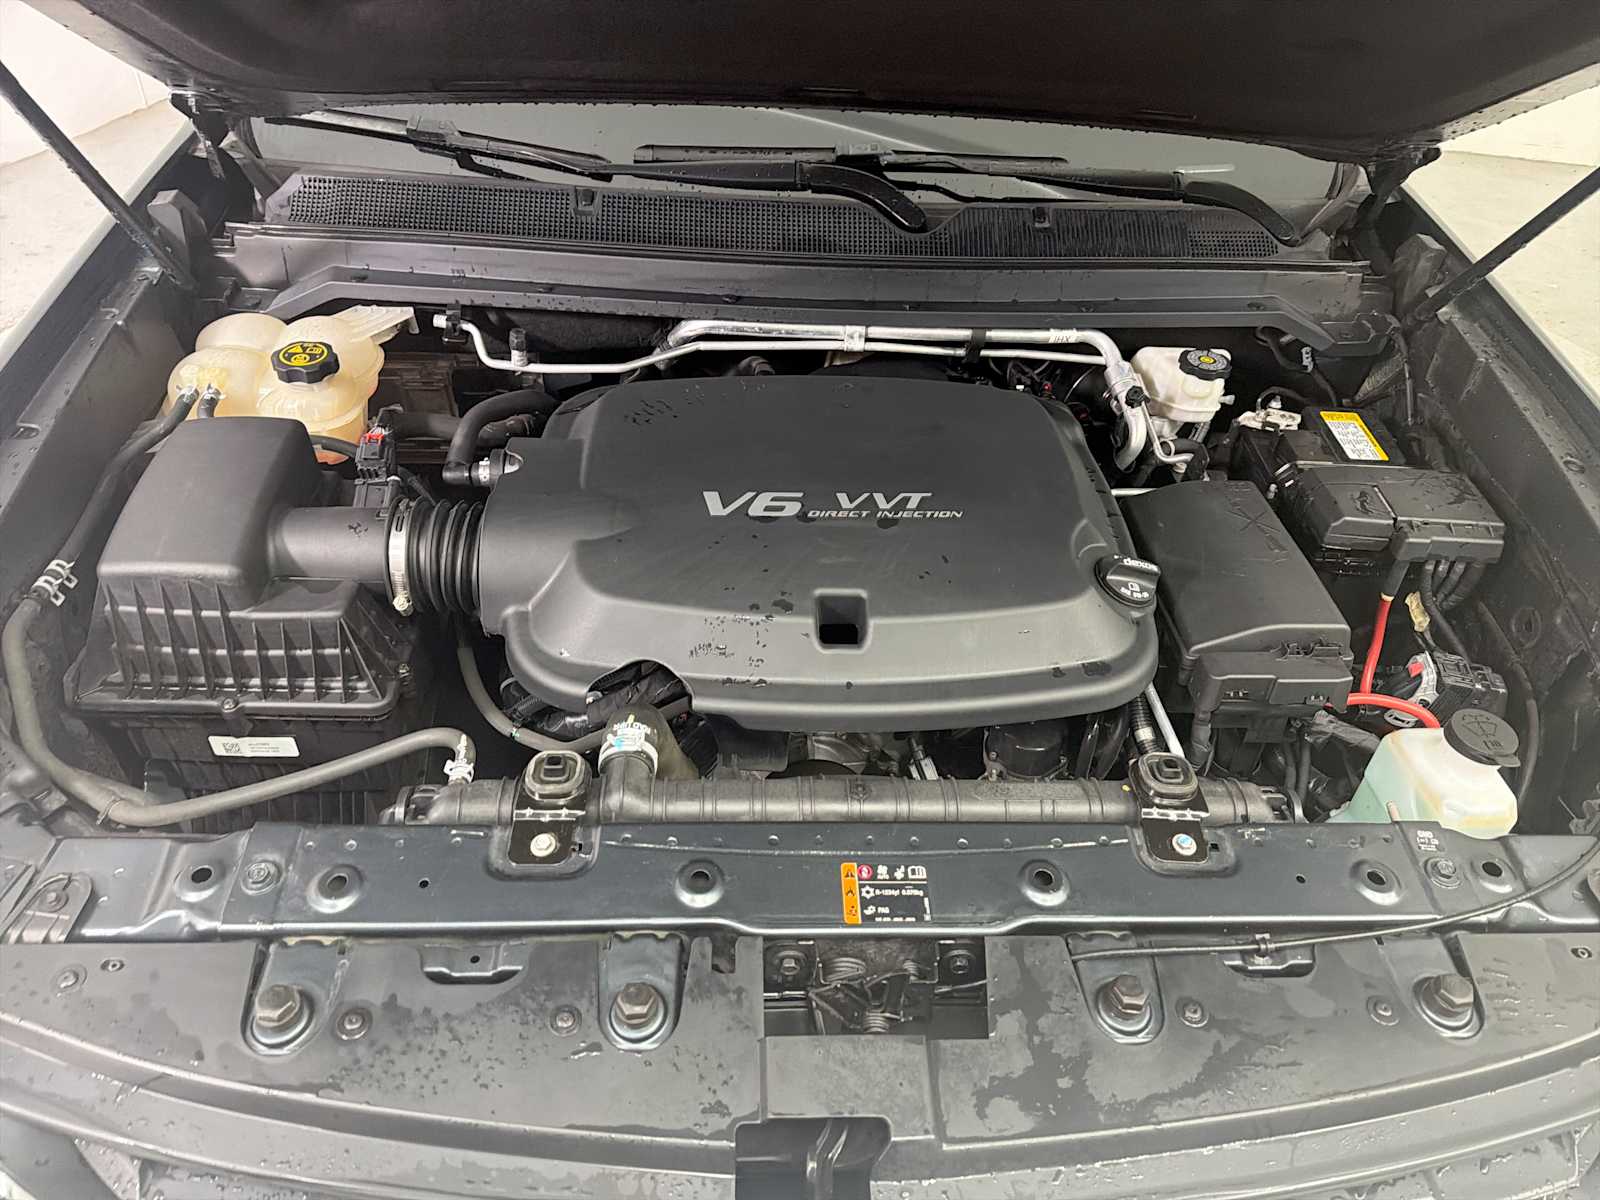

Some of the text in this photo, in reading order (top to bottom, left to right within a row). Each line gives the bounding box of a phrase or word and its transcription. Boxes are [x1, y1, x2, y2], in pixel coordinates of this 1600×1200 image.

[702, 490, 804, 517] V6
[835, 492, 933, 509] VVT
[807, 510, 964, 519] DIRECT INJECTION
